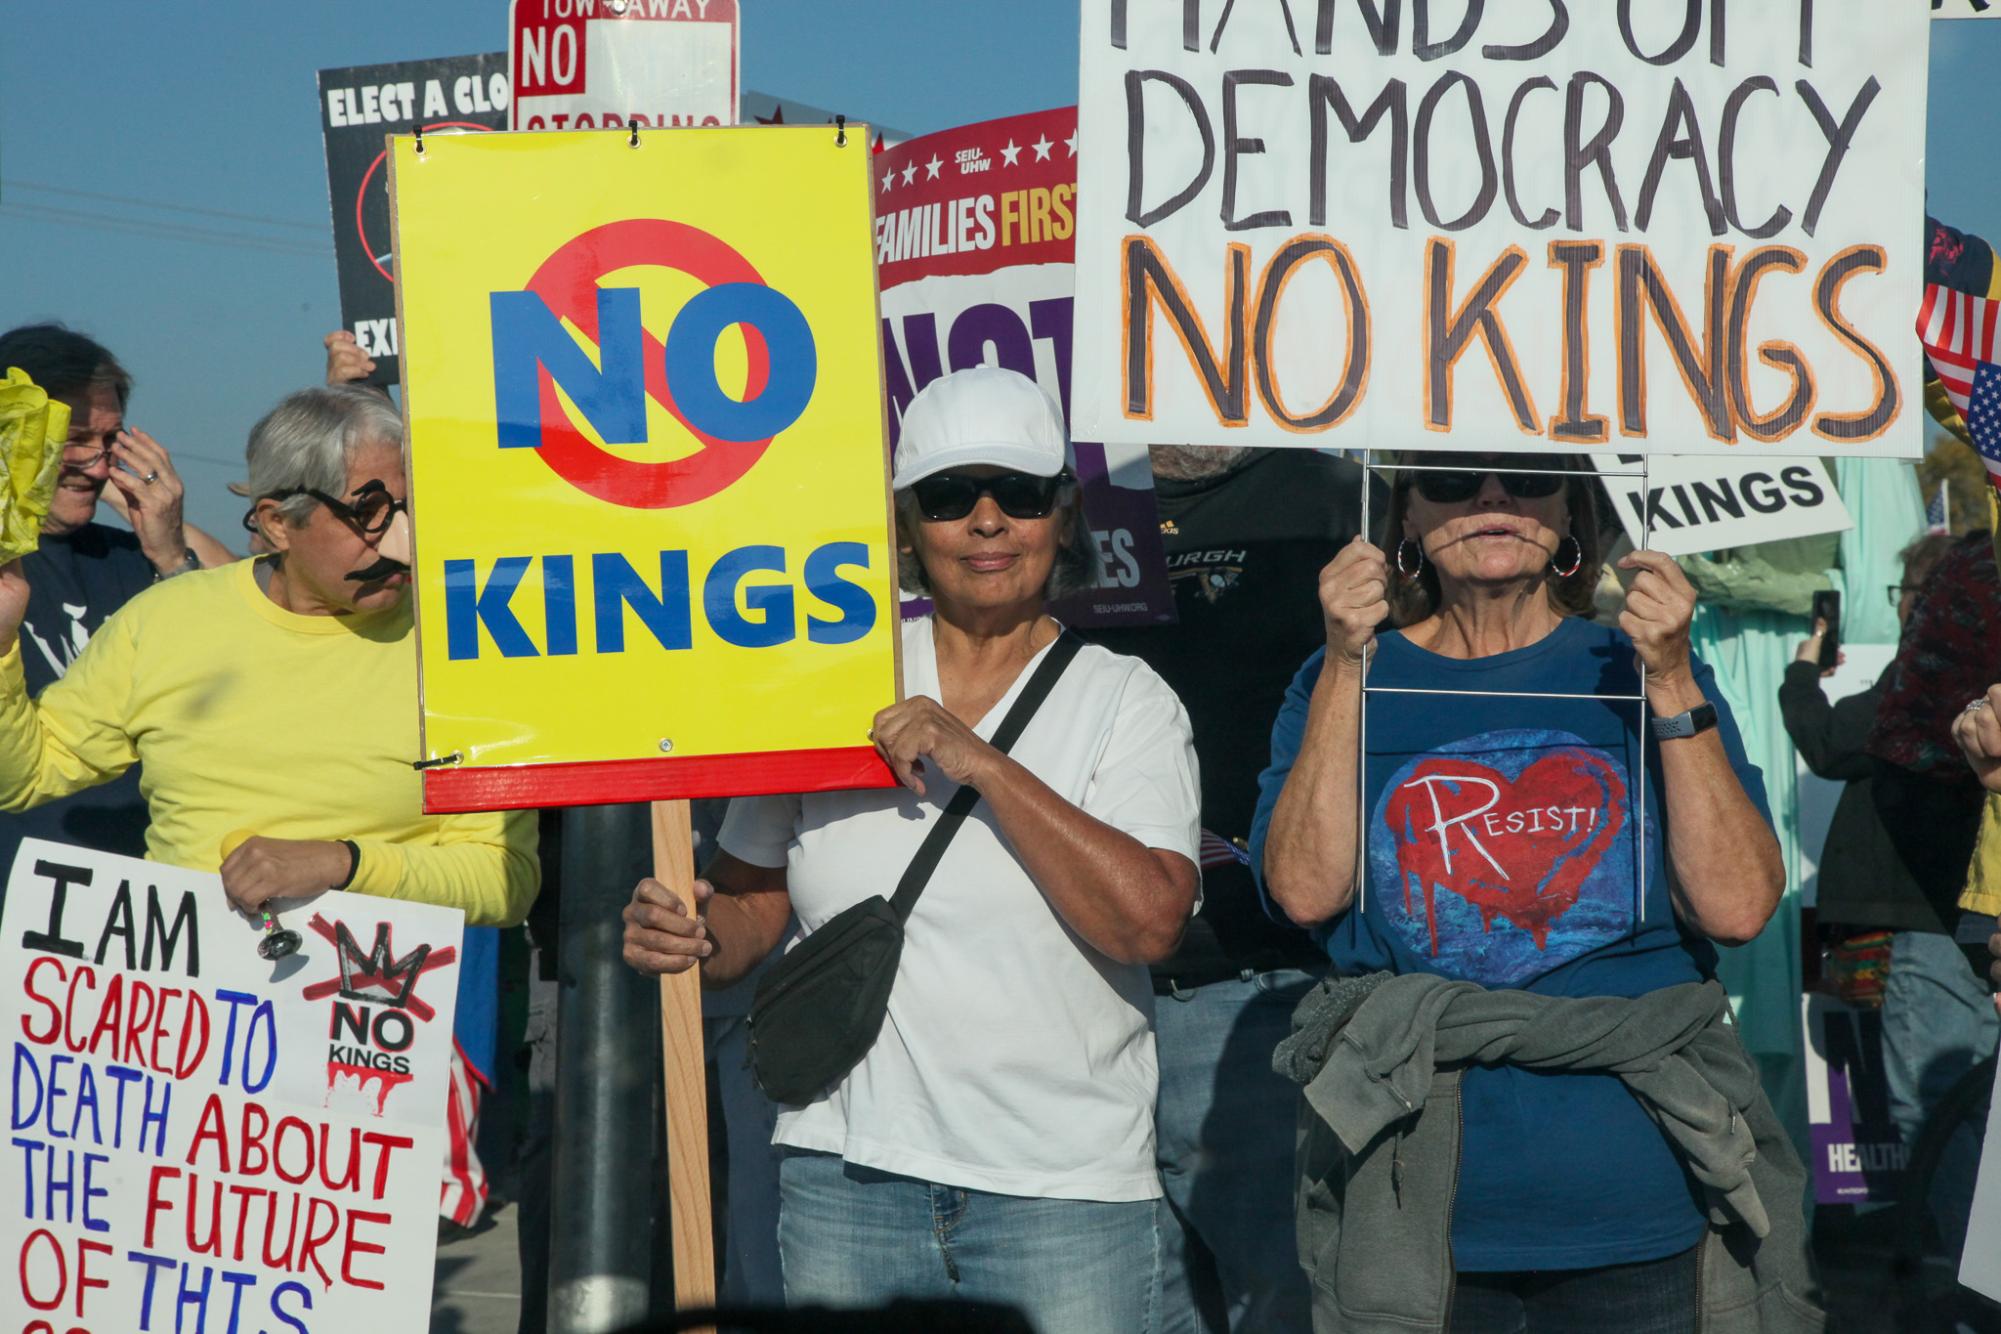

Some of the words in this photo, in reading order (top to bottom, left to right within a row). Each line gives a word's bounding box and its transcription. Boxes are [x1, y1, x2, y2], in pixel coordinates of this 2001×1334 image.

[327, 82, 416, 128] ELECT
[423, 79, 449, 118] A
[521, 24, 578, 88] NO
[960, 158, 992, 175] UHW
[1124, 69, 1882, 239] DEMOCRACY
[489, 282, 818, 449] NO
[1121, 232, 1372, 434] NO
[1424, 236, 1903, 445] KINGS
[1626, 466, 1825, 533] KINGS
[443, 541, 878, 661] KINGS
[1403, 775, 1597, 881] RESIST!
[22, 859, 94, 960] I
[94, 879, 201, 978] AM
[20, 956, 211, 1081] SCARED
[215, 988, 278, 1095] TO
[328, 1043, 411, 1075] KINGS
[329, 1000, 415, 1053] NO
[11, 1041, 172, 1157] DEATH
[186, 1093, 414, 1201] ABOUT
[11, 1136, 110, 1233] THE
[143, 1165, 392, 1293] FUTURE
[19, 1228, 114, 1319] OF
